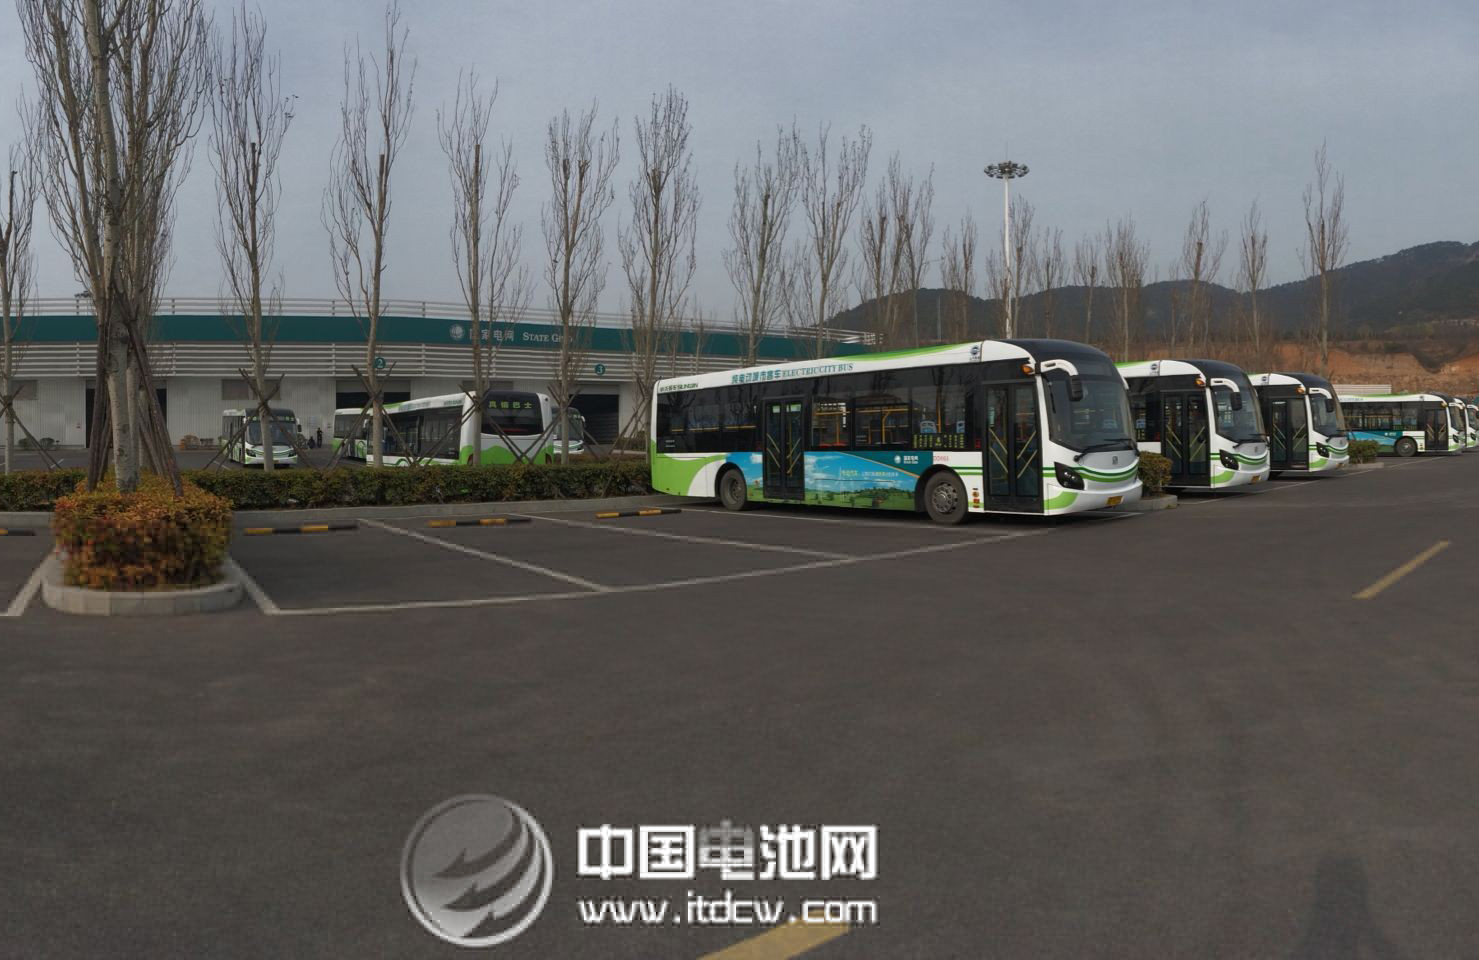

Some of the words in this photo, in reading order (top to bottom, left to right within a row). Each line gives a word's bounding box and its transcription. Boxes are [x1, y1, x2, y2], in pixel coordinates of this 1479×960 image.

[470, 328, 514, 342] 家电网
[523, 332, 549, 342] STATE
